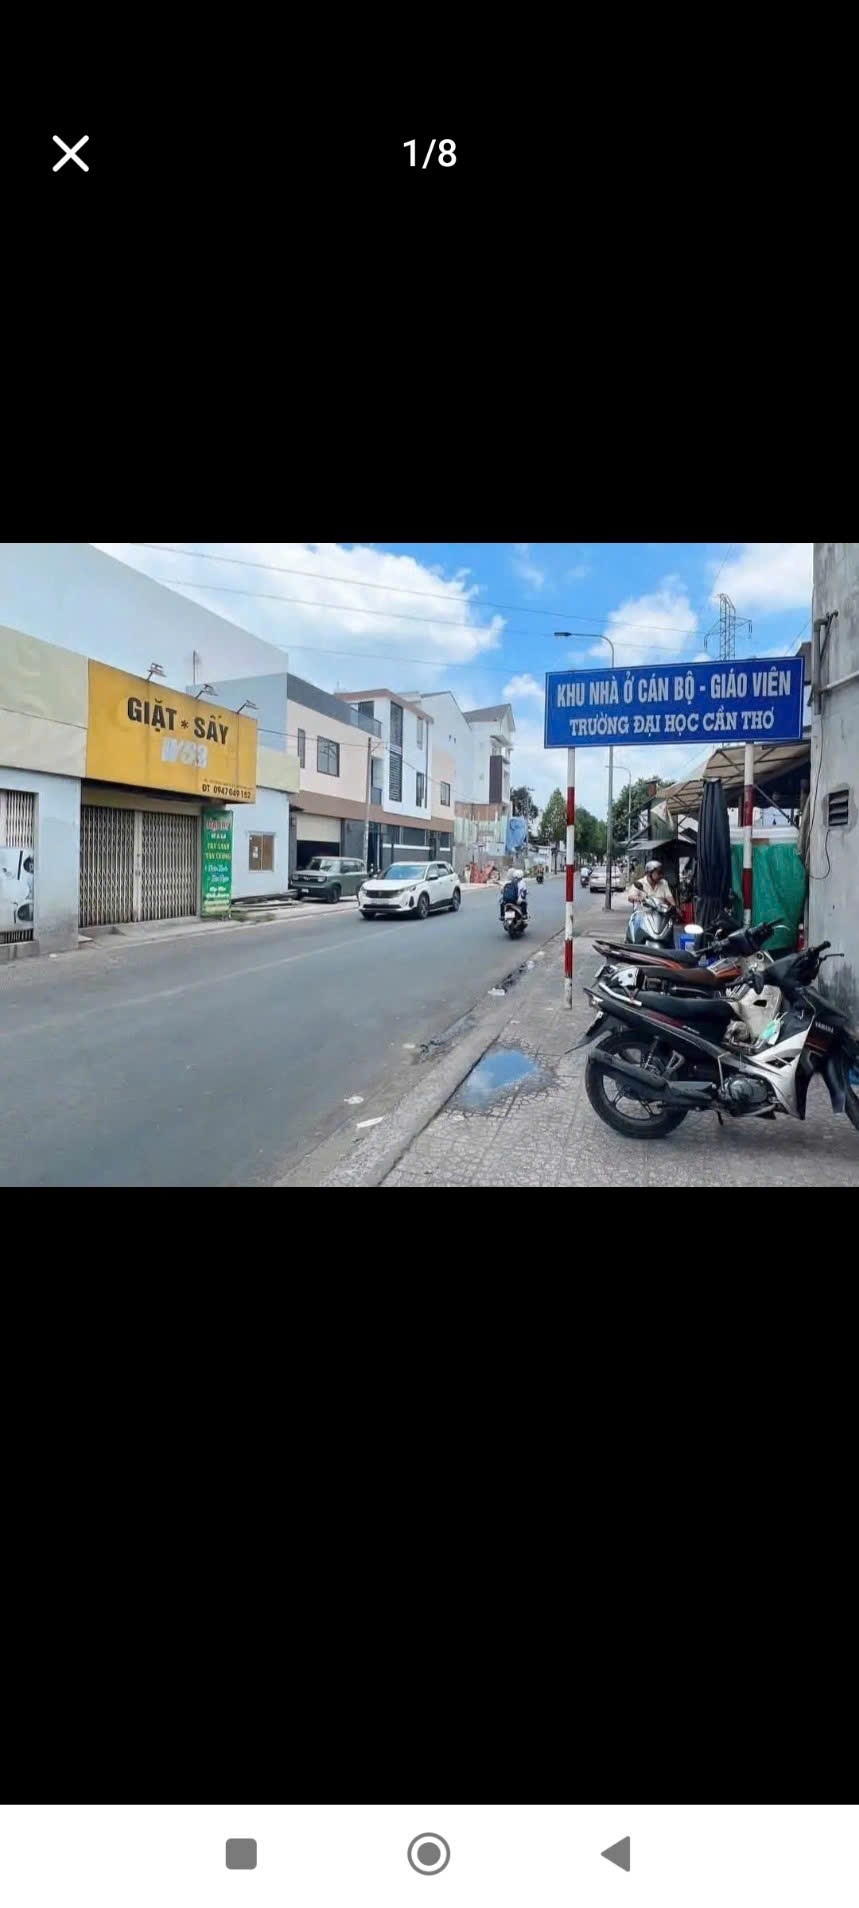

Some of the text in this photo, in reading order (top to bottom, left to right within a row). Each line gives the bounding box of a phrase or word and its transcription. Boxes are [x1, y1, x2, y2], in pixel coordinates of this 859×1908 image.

[556, 682, 585, 708] KHU
[589, 675, 619, 705] NHÀ
[623, 671, 634, 703] Ở
[638, 673, 669, 703] CÁN
[674, 670, 695, 705] BỘ
[710, 668, 747, 699] GIÁO
[752, 666, 791, 697] VIÊN
[127, 697, 229, 745] GIẶT SẤY
[569, 704, 775, 737] TRƯỜNG ĐẠI HỌC CẦN THƠ
